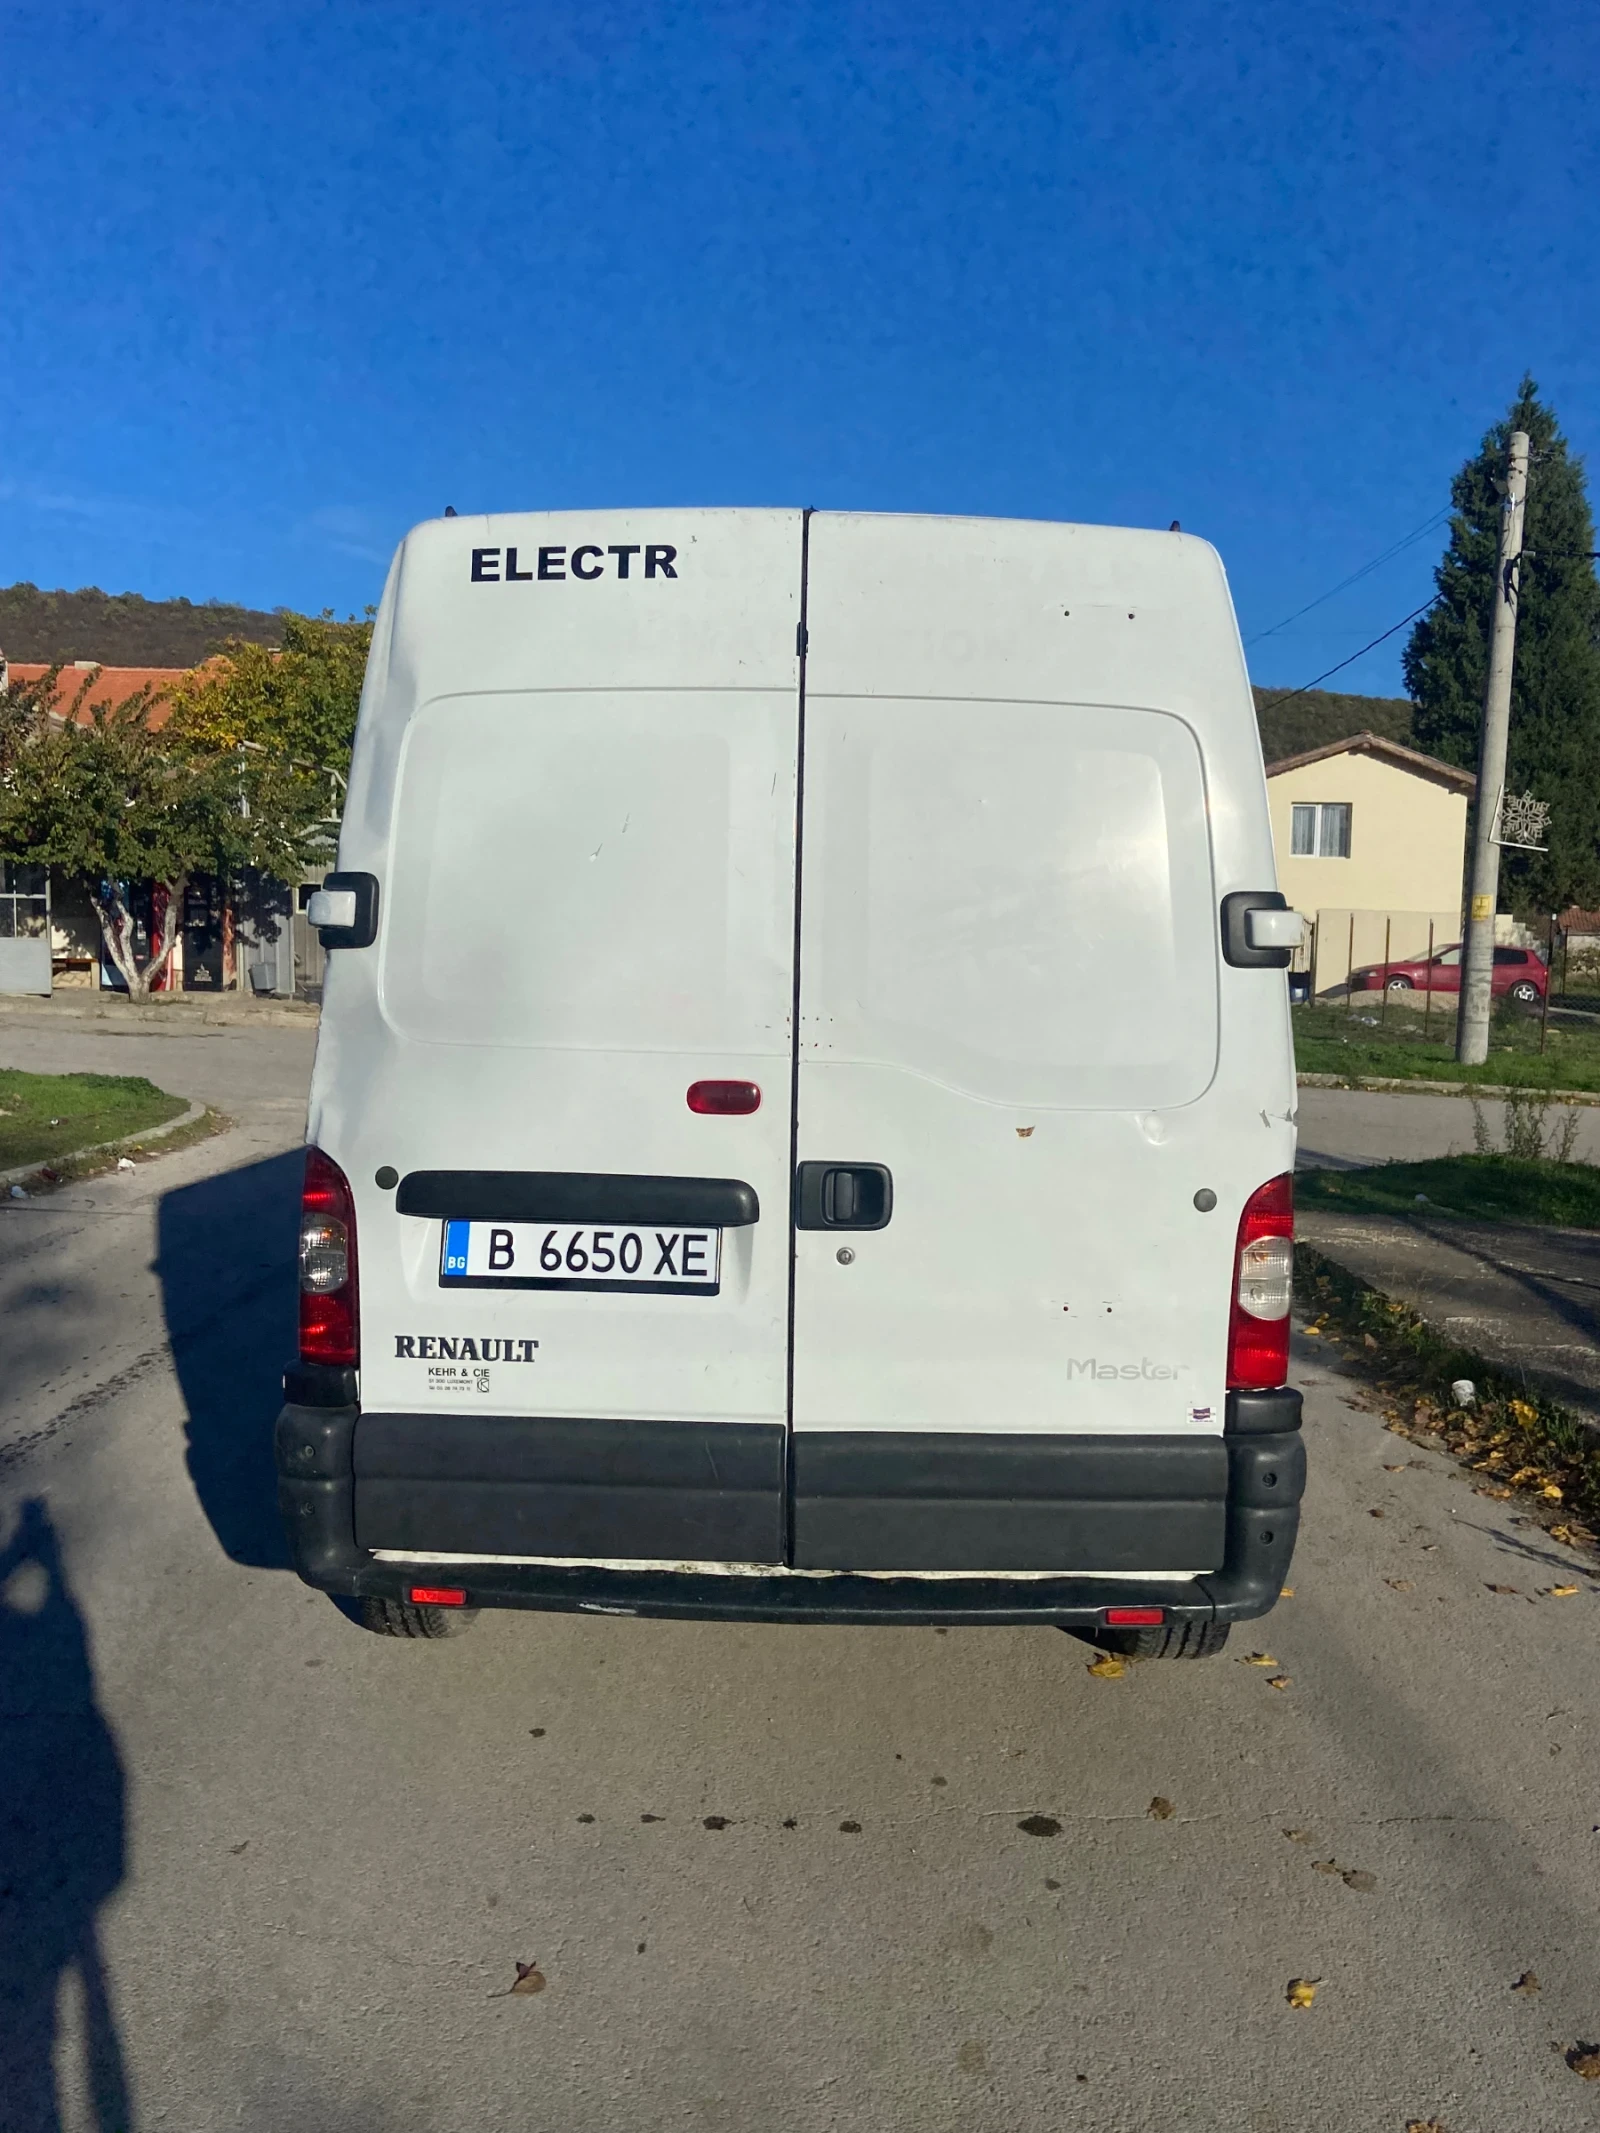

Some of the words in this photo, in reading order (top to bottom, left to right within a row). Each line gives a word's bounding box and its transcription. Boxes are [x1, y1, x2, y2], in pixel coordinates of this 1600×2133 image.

[471, 545, 679, 582] ELECTR
[447, 1256, 466, 1269] BG
[488, 1229, 515, 1271] B
[540, 1230, 643, 1273] 6650
[653, 1233, 709, 1276] XE
[394, 1335, 540, 1363] RENAULT
[428, 1367, 457, 1377] KEHR
[461, 1368, 468, 1377] &
[473, 1368, 490, 1378] CIE
[1066, 1356, 1190, 1381] Master
